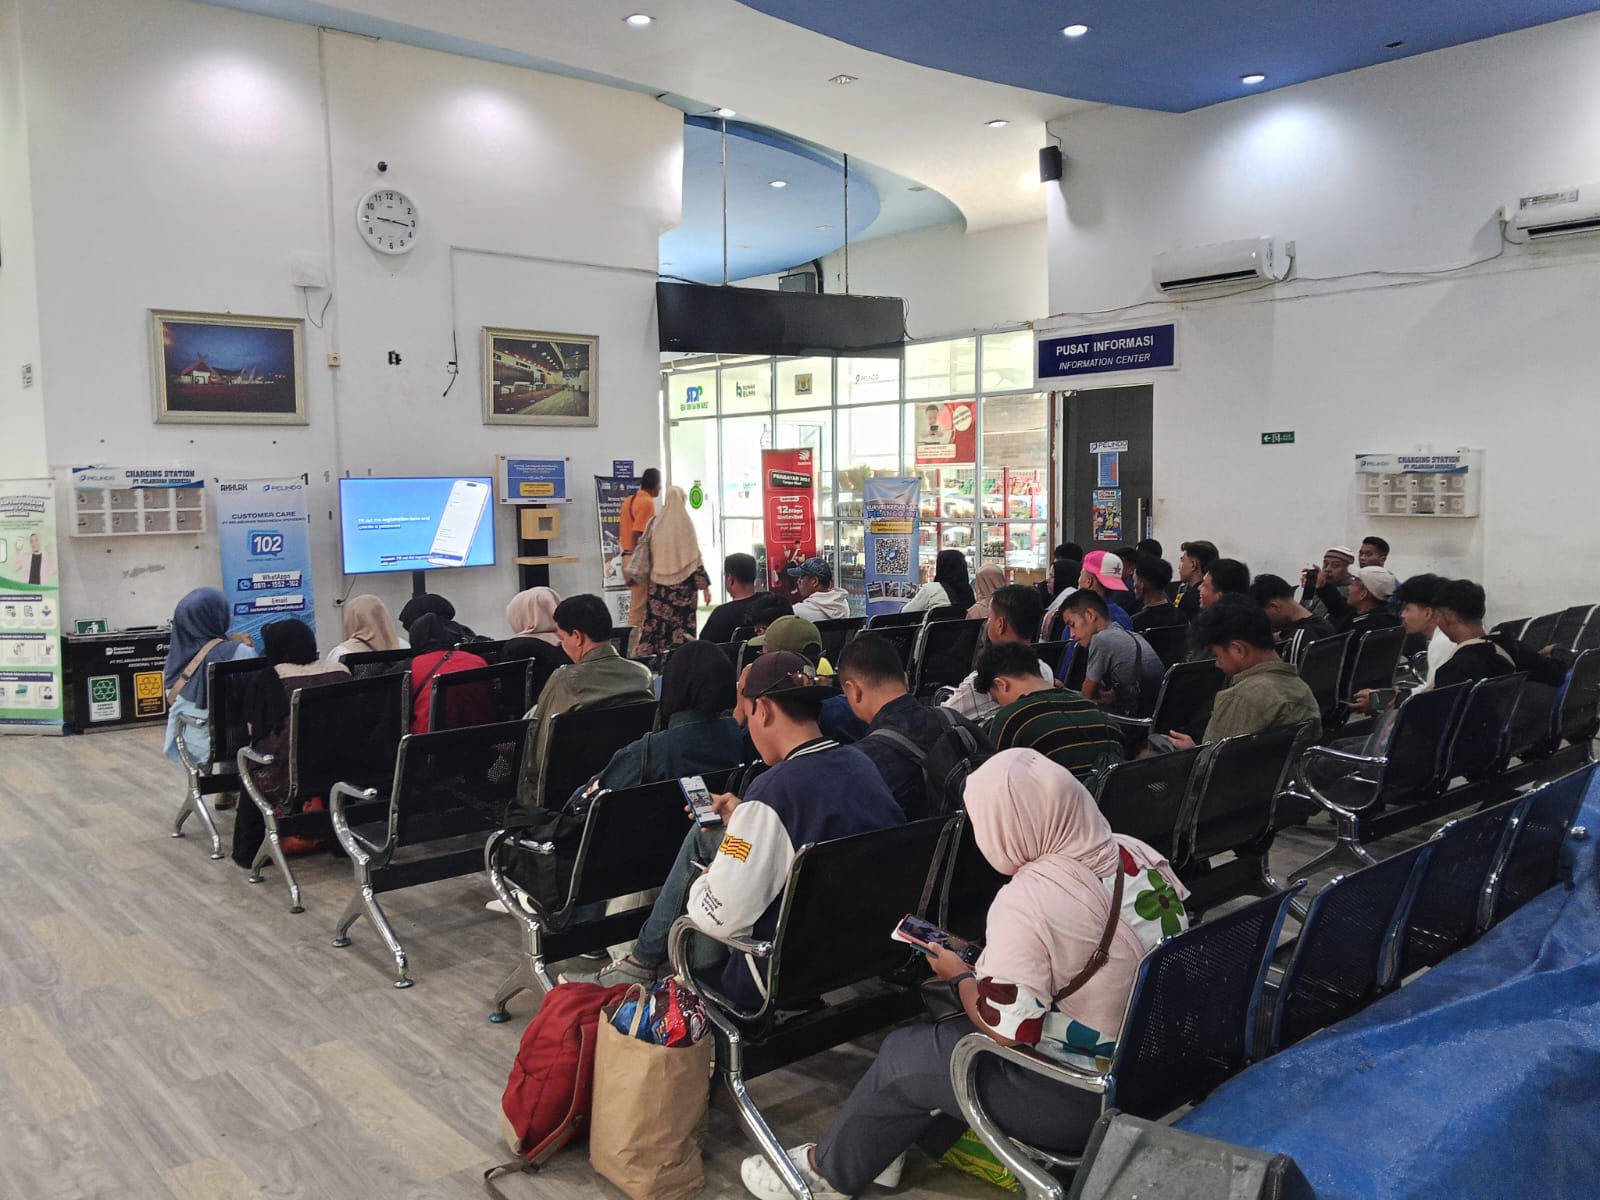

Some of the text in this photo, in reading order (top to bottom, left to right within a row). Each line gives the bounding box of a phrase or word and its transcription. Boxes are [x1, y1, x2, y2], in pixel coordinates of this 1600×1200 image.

[1056, 335, 1154, 356] PUSAT INFORMASI
[1059, 353, 1151, 371] INFORMATION CENTER
[1099, 441, 1127, 449] PELINDO
[1397, 456, 1431, 464] CHARGING
[125, 470, 195, 478] CHARGING STATION
[220, 484, 248, 492] AKHLAK
[231, 512, 274, 520] CUSTOMER
[253, 536, 282, 553] 102
